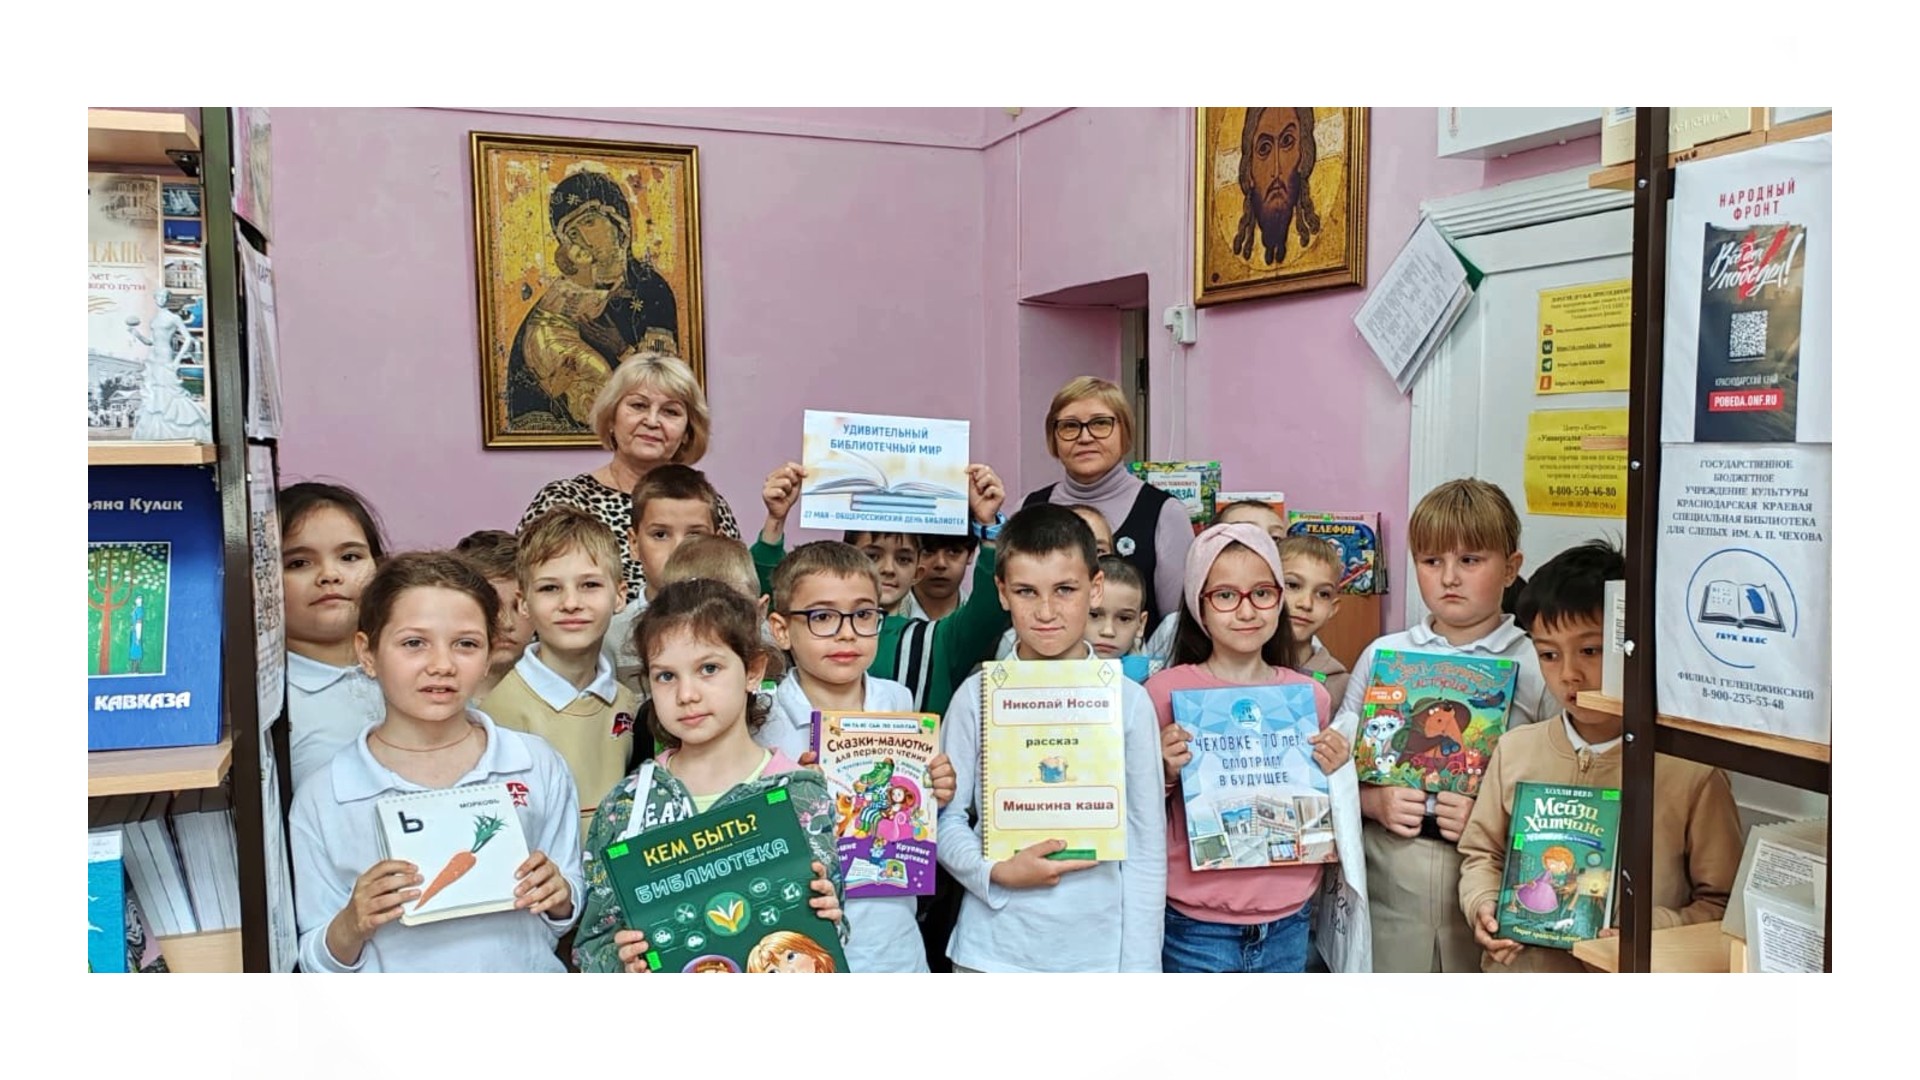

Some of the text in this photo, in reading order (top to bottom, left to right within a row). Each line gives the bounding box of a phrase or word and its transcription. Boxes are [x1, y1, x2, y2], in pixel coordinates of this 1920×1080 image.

[1719, 177, 1796, 207] НАРОДНЫЙ
[1733, 200, 1780, 220] ФРОНТ
[1715, 375, 1761, 387] КРАСНОДАРСКИЙ
[1714, 394, 1777, 407] POBEDA.ONF.RU
[843, 423, 929, 440] УДИВИТЕЛЬНЫЙ
[830, 439, 942, 455] БИБЛИОТЕЧНЫЙ МИР
[1700, 459, 1793, 469] ГОСУДАРСТВЕННОЕ
[1713, 473, 1775, 483] БЮДЖЕТНОЕ
[1685, 485, 1809, 498] УЧРЕЖДЕНИЕ КУЛЬТУРЫ
[130, 497, 183, 514] Кулик
[1677, 498, 1813, 512] КРАСНОДАРСКАЯ КРАЕВАЯ
[1672, 512, 1816, 527] СПЕЦИАЛЬНАЯ БИБЛИОТЕКА
[1306, 524, 1355, 534] ТЕЛЕФОН
[1666, 525, 1823, 542] ДЛЯ СЛЕПЫХ ИМ. А. П. ЧЕХОВА
[1677, 671, 1815, 701] ФИЛИАЛ ГЕЛЕНДЖИКСКИЙ
[94, 691, 191, 712] КАВКАЗА
[1003, 698, 1110, 710] Николай Носов
[1702, 688, 1785, 710] 8-900-235-53-48
[827, 736, 933, 754] Сказки-малютки
[1026, 737, 1079, 748] рассказ
[1195, 735, 1251, 752] ЧЕХОВКЕ
[1262, 733, 1278, 748] 70
[835, 748, 927, 764] для первого чтения
[1222, 755, 1282, 770] СМОТРИМ
[1220, 772, 1289, 787] В БУДУЩЕЕ
[459, 799, 501, 809] МОРКОВЬ
[1003, 800, 1114, 812] Мишкина каша
[1534, 797, 1598, 821] Мейзи
[398, 811, 424, 834] Ь
[1523, 815, 1604, 837] Хитчинс
[643, 838, 689, 867] КЕМ
[692, 814, 759, 851] БЫТЬ?
[896, 842, 930, 857] Крупные
[895, 853, 929, 866] картинки
[635, 838, 789, 904] БИБЛИОТЕКА
